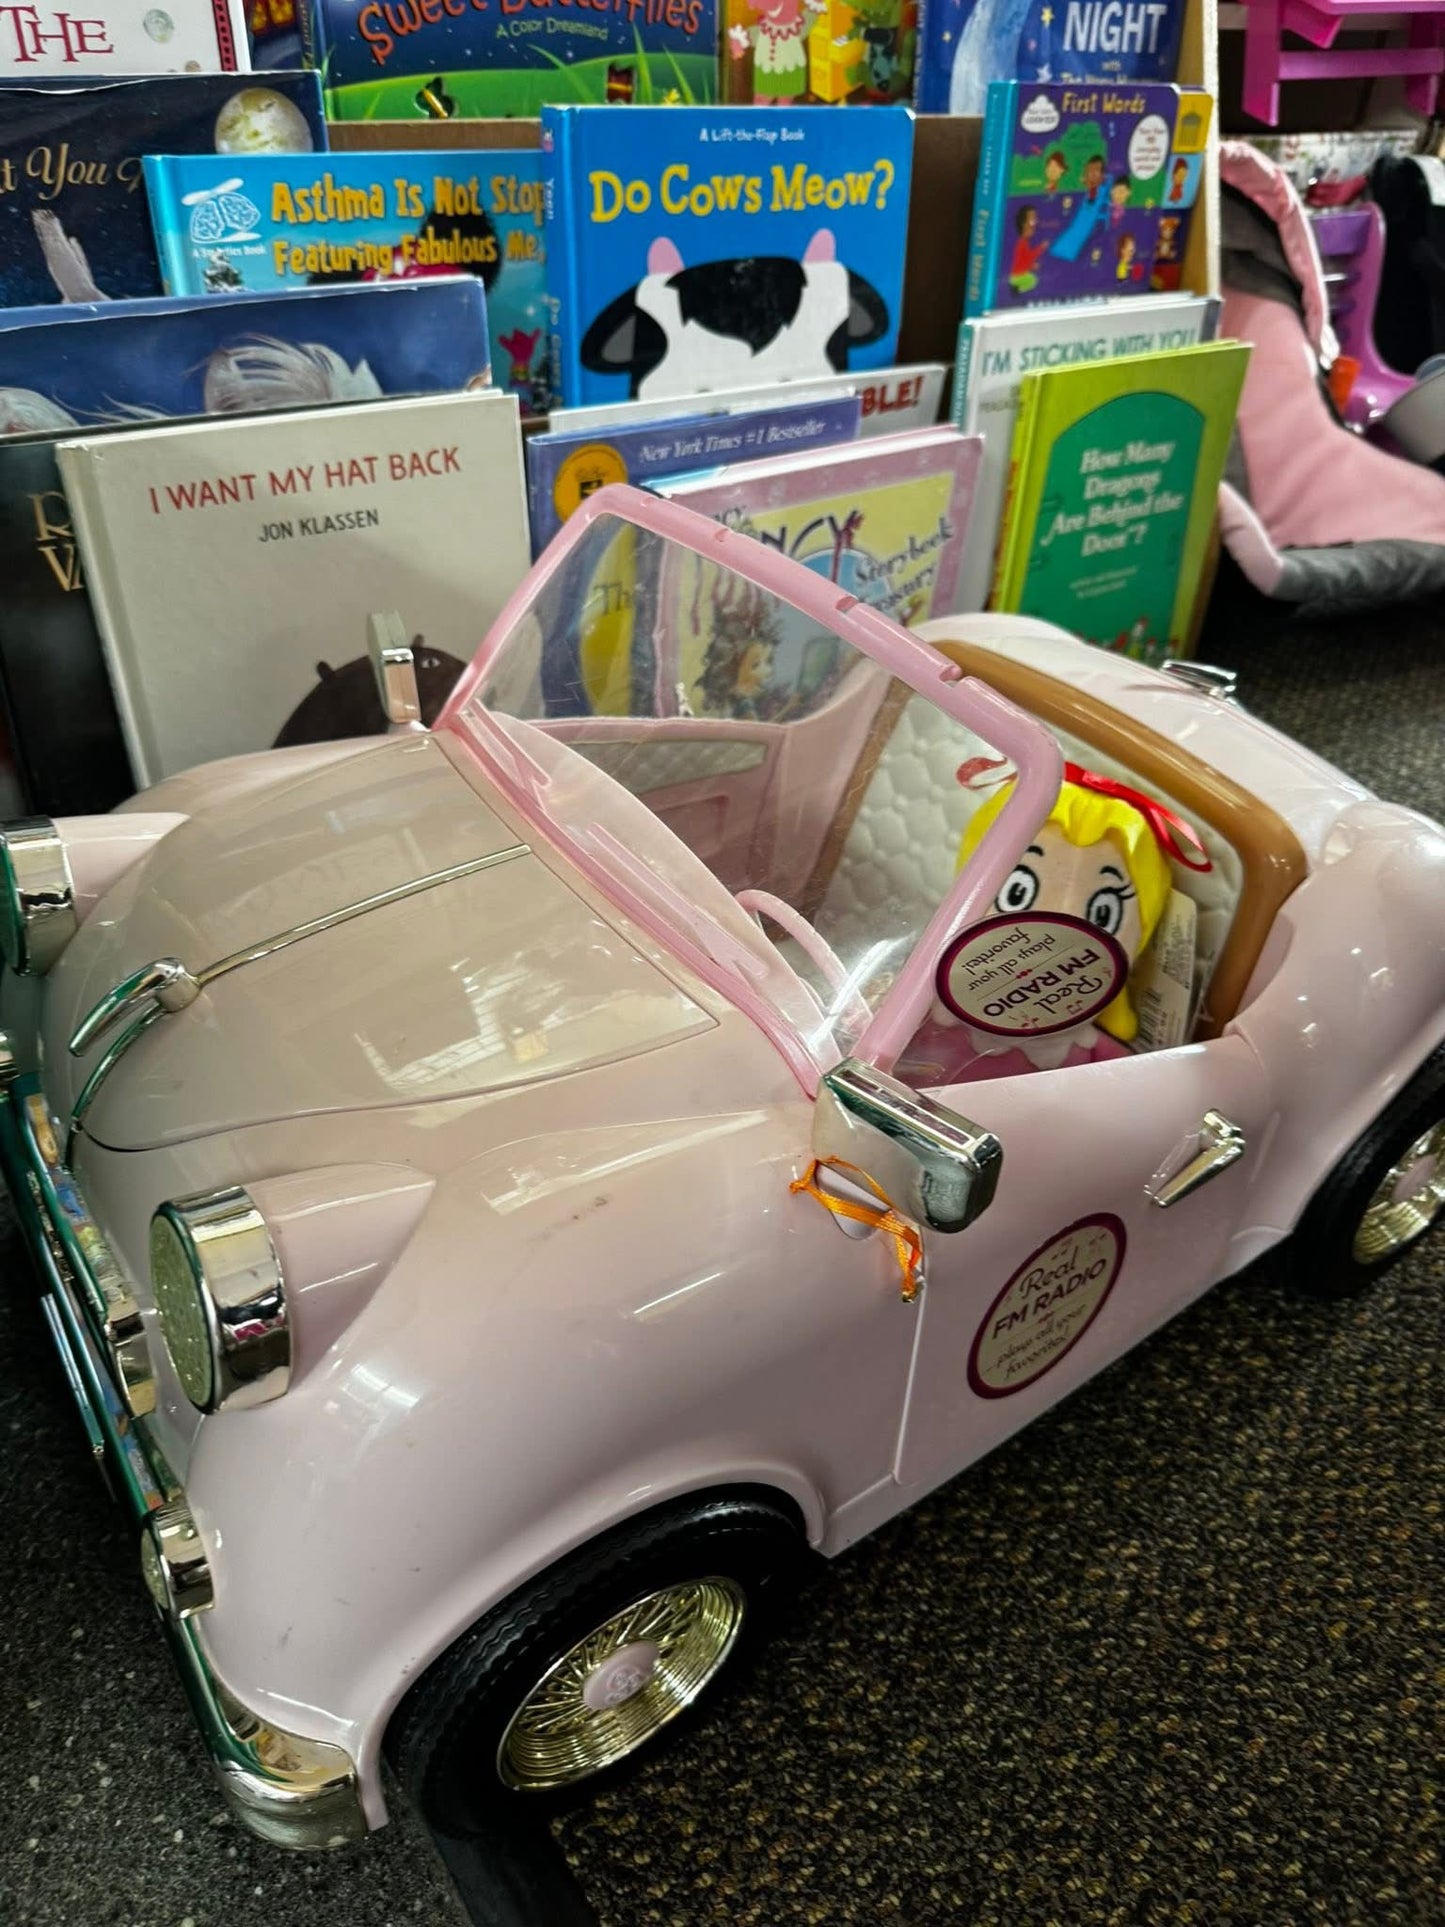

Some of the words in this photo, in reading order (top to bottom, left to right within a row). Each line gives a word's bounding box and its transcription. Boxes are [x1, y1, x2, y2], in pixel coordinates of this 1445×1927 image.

[0, 5, 114, 63] THE
[496, 23, 508, 39] A
[509, 18, 544, 37] Color
[1063, 1, 1167, 53] NIGHT
[1062, 91, 1098, 114] First
[1103, 92, 1147, 114] Words
[699, 128, 709, 142] A
[780, 127, 805, 142] Book
[26, 143, 107, 200] You
[588, 170, 651, 223] Do
[661, 164, 762, 216] Cows
[770, 159, 895, 212] Meow?
[272, 172, 385, 223] Asthma
[394, 178, 425, 217] Is
[433, 176, 484, 216] Not
[272, 240, 394, 277] Featuring
[401, 225, 497, 266] Fabulous
[982, 349, 1011, 376] I'M
[1019, 338, 1106, 372] STICKING
[1112, 333, 1152, 357] WITH
[1159, 328, 1197, 350] YOU
[861, 373, 925, 418] BLE!
[640, 445, 672, 463] New
[673, 438, 702, 458] York
[705, 434, 743, 452] Times
[745, 426, 764, 445] #1
[766, 419, 826, 443] Bestseller
[1080, 447, 1123, 474] How
[1125, 440, 1178, 464] Many
[149, 487, 161, 514] I
[166, 474, 257, 512] WANT
[268, 466, 315, 495] MY
[324, 456, 379, 489] HAT
[389, 446, 462, 482] BACK
[1084, 470, 1162, 500] Dragons
[258, 520, 294, 543] JON
[299, 509, 380, 538] KLASSEN
[1040, 511, 1086, 546] Are
[1087, 495, 1154, 527] Behind
[1154, 492, 1184, 513] the
[856, 517, 954, 583] Storybook
[962, 927, 1031, 976] favorites!
[996, 959, 1019, 978] all
[1018, 933, 1056, 966] plays
[1057, 948, 1101, 976] FM
[968, 970, 997, 991] your
[983, 970, 1061, 1017] RADIO
[1033, 976, 1103, 1015] Real
[1019, 1245, 1079, 1299] Real
[992, 1304, 1029, 1340] FM
[1033, 1258, 1107, 1315] RADIO
